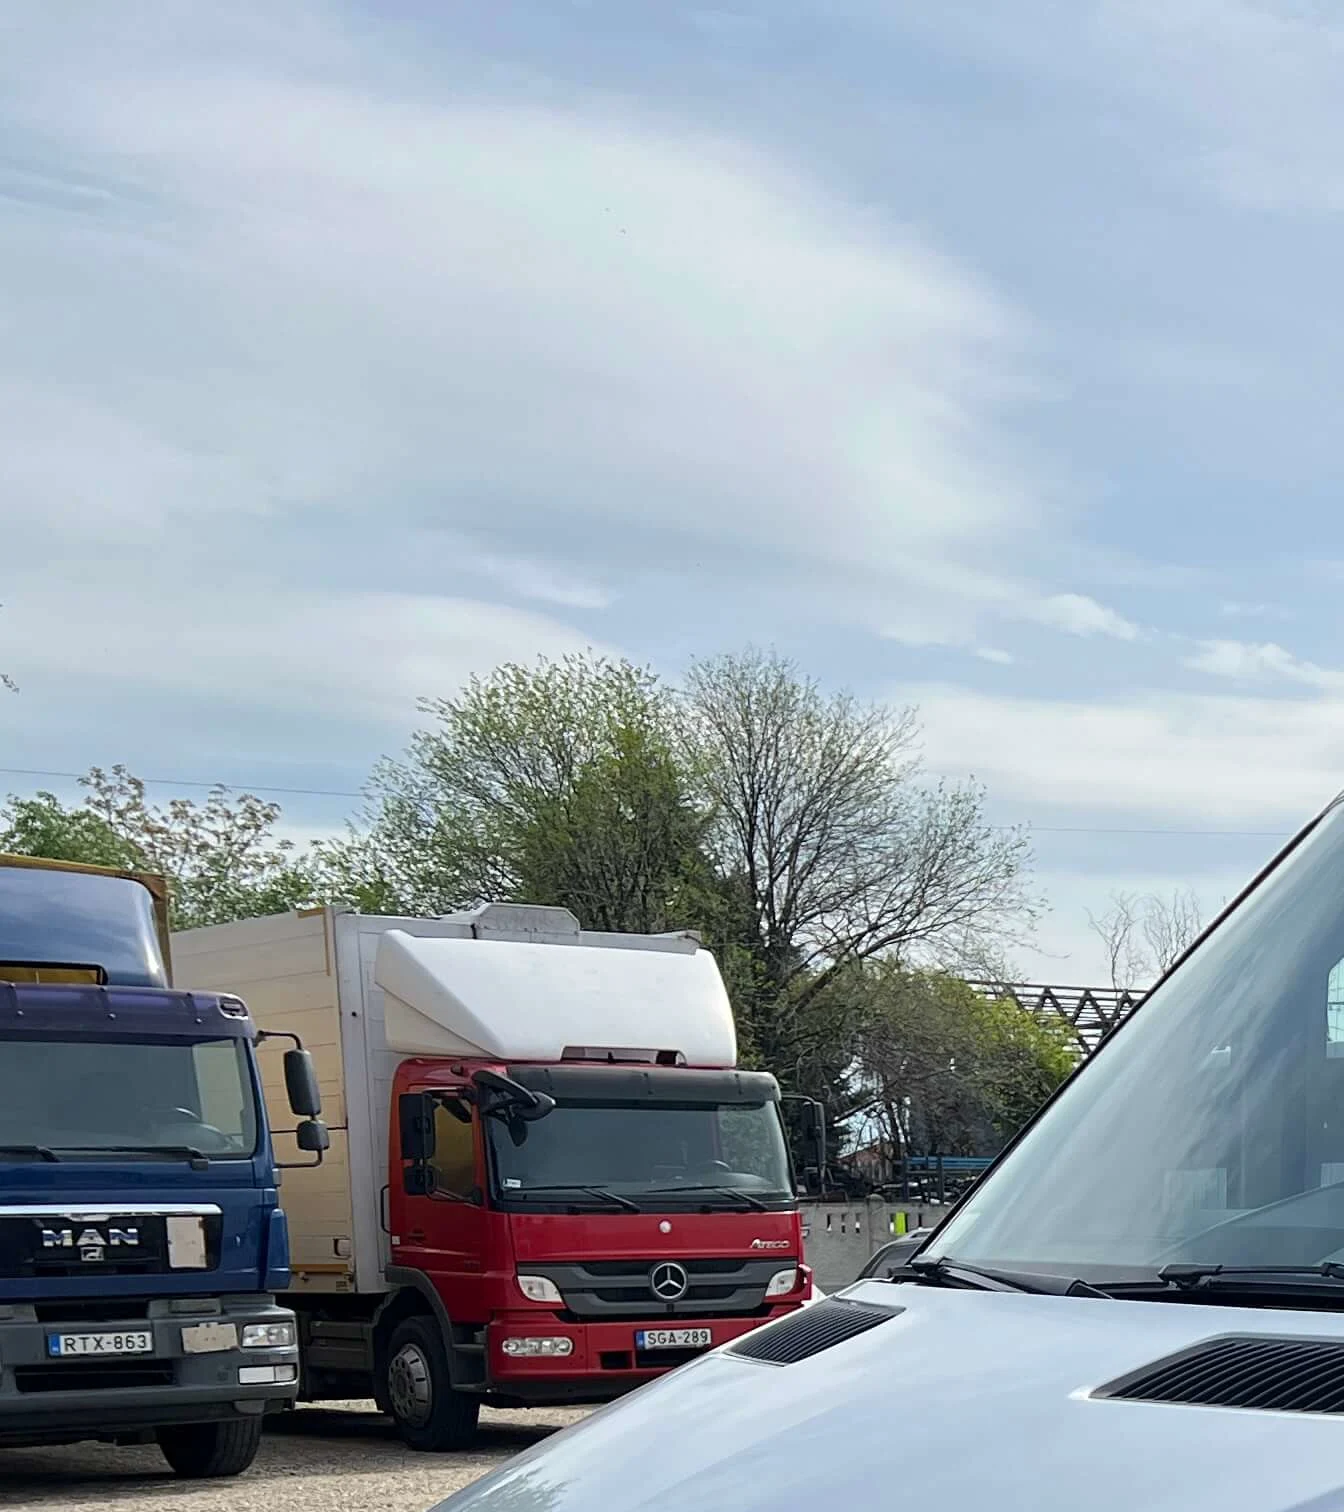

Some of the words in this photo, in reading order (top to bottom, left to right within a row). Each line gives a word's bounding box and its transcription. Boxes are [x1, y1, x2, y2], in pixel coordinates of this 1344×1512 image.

[42, 1228, 139, 1247] MAN
[64, 1334, 147, 1352] RTX-863
[647, 1330, 708, 1345] SGA-289
